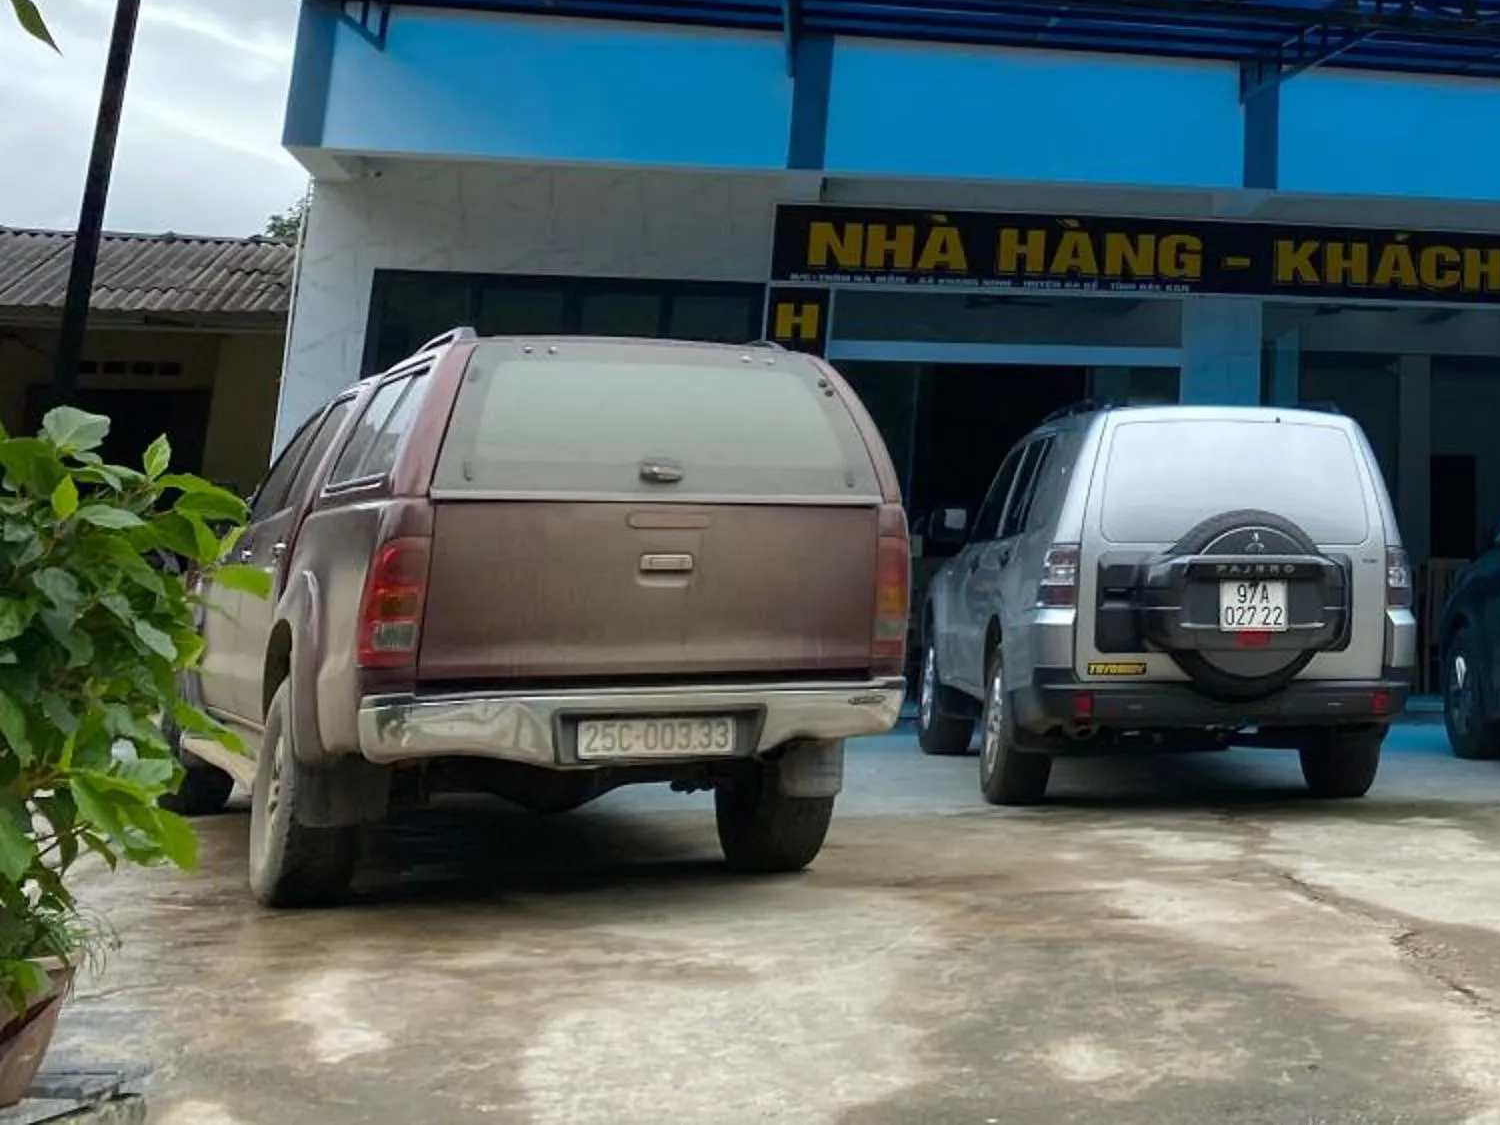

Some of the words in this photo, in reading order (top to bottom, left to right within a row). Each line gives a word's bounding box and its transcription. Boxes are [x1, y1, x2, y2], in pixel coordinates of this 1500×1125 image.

[808, 214, 968, 270] NHÀ
[997, 218, 1203, 281] HÀNG
[1237, 583, 1269, 605] 97A
